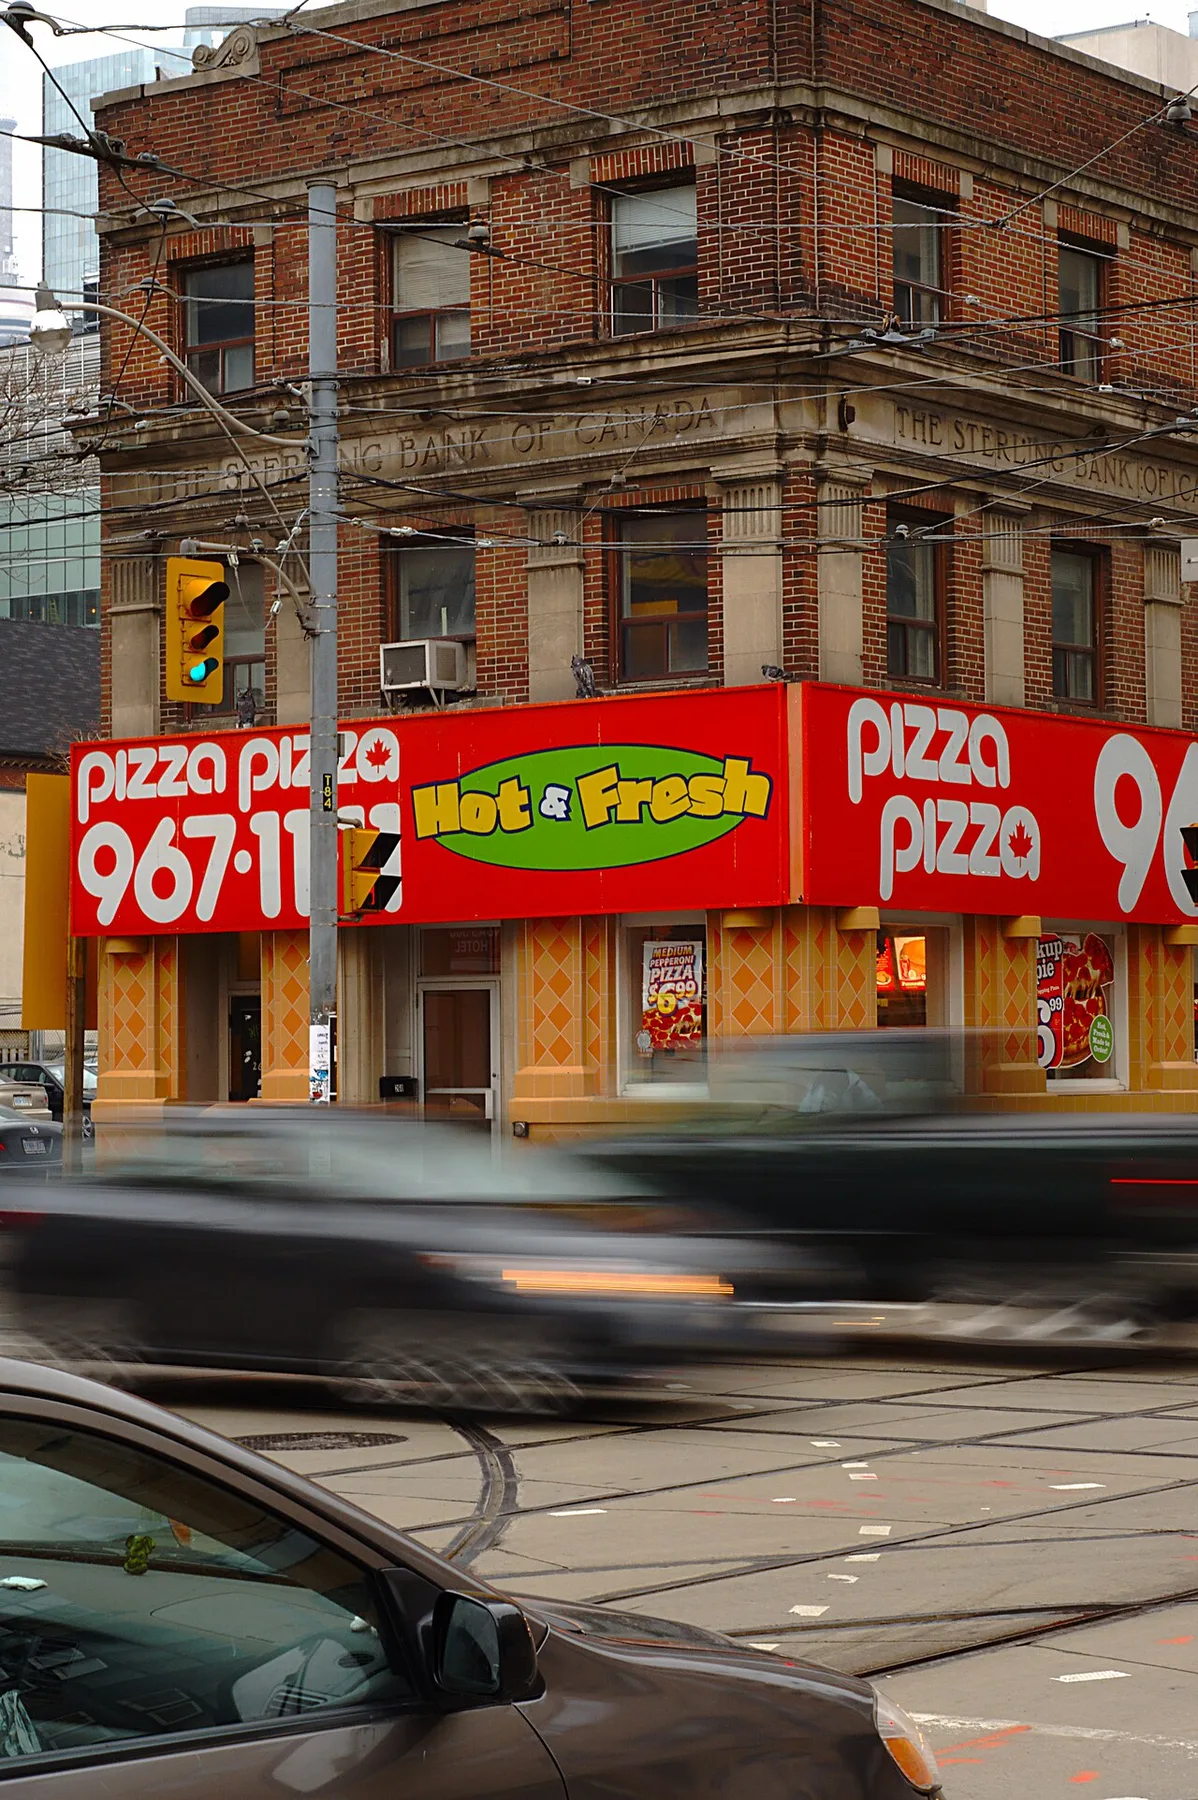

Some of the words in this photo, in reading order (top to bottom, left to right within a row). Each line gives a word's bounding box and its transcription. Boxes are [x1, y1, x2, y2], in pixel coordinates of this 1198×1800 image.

[150, 466, 211, 500] THE
[225, 443, 382, 491] STERNG
[400, 427, 493, 469] BANK
[511, 419, 555, 453] OF
[574, 396, 718, 447] CANADA
[896, 406, 942, 446] THE
[953, 419, 1065, 476] STERLING
[1074, 448, 1133, 490] BANK
[1143, 466, 1168, 496] OF
[78, 743, 227, 825] pizza
[848, 698, 1010, 804] pizza
[324, 775, 332, 809] T84
[413, 778, 532, 839] Hot
[540, 786, 571, 821] &
[577, 759, 770, 827] Fresh
[879, 795, 1040, 902] pizza
[649, 955, 694, 968] PEPPERONI
[650, 965, 693, 983] PIZZA
[653, 945, 693, 958] MEDIUM
[1036, 940, 1063, 961] kup
